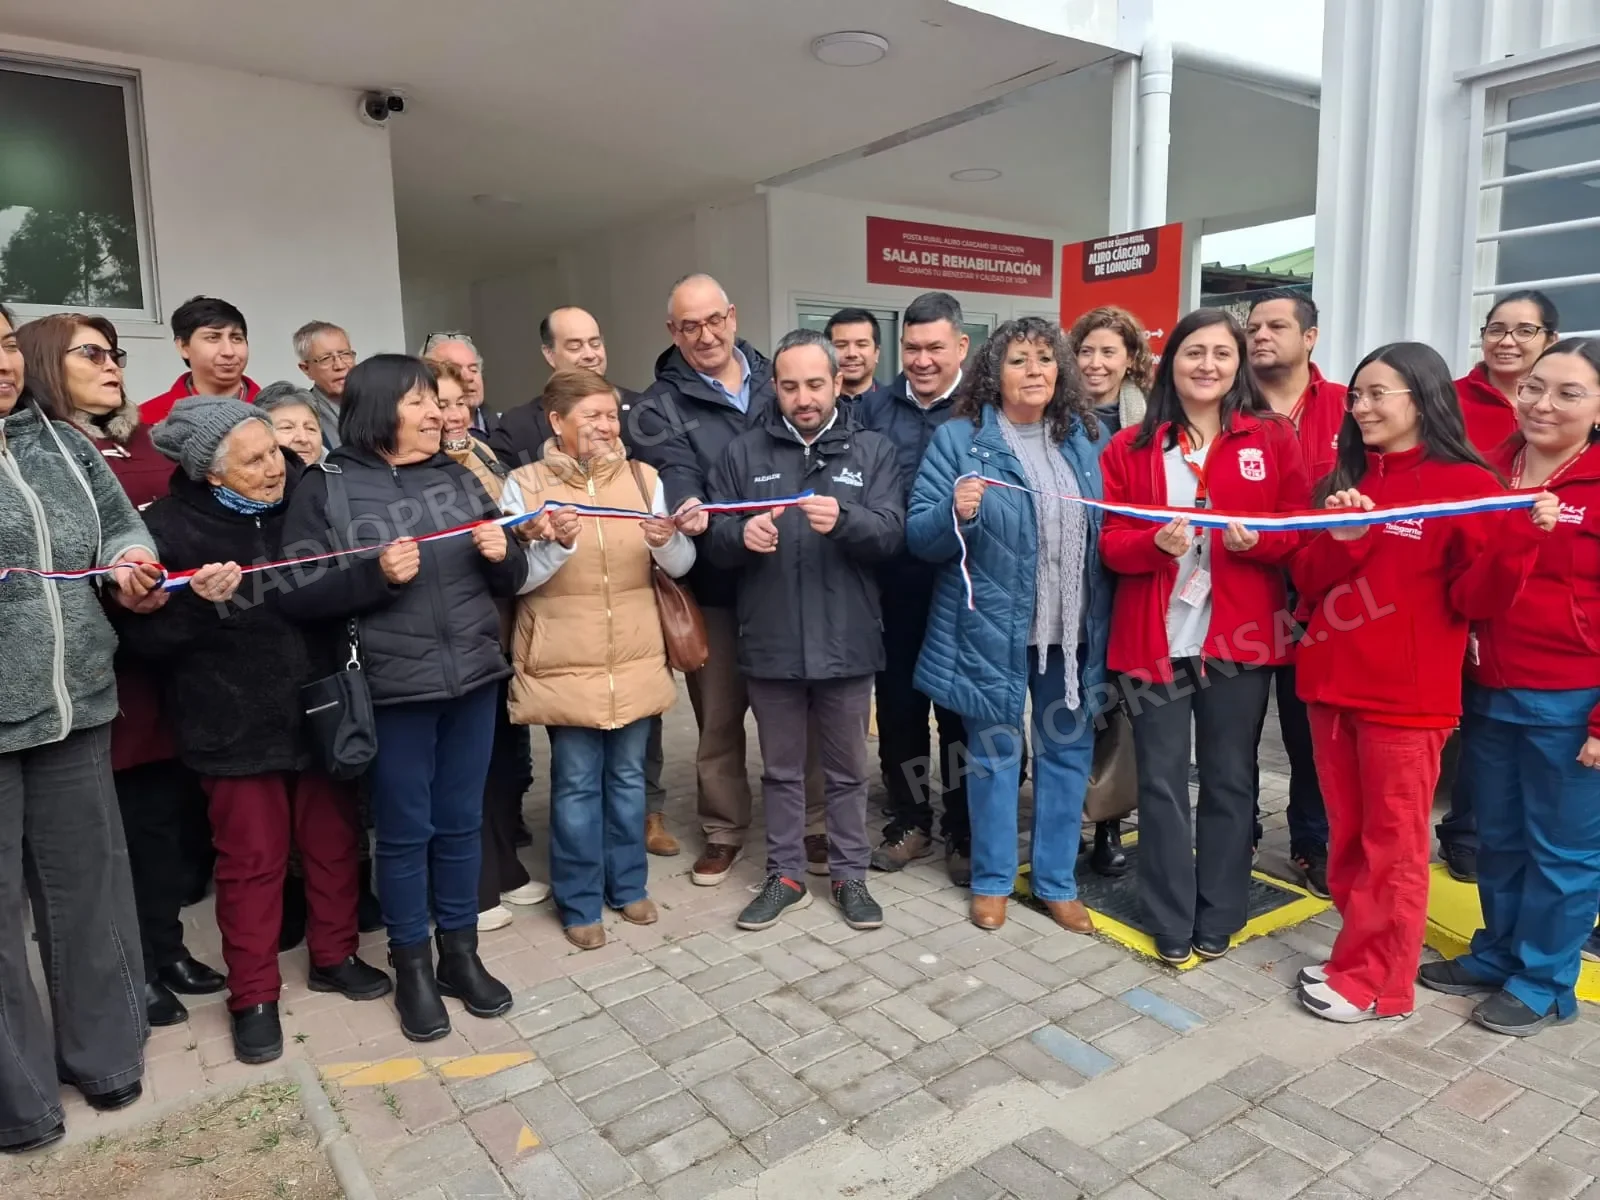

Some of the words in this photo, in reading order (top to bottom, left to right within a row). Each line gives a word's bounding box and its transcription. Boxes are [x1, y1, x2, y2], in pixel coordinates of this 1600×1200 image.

[902, 233, 922, 241] POSTA
[923, 235, 942, 244] RURAL
[944, 238, 960, 246] ALIRO
[1094, 240, 1108, 251] POSTA
[1108, 240, 1115, 248] DE
[1115, 238, 1129, 247] SALUD
[1129, 234, 1144, 244] RURAL
[882, 247, 919, 264] SALA
[921, 252, 940, 266] DE
[942, 254, 1041, 276] REHABILITACIÓN
[1088, 250, 1111, 265] ALIRO
[1112, 243, 1150, 261] CÁRCAMO
[898, 266, 932, 276] CUIDAMOS
[933, 269, 941, 277] TU
[942, 271, 974, 280] BIENESTAR
[980, 274, 1005, 283] CALIDAD
[1094, 264, 1105, 276] DE
[1106, 257, 1142, 274] LONQUÉN
